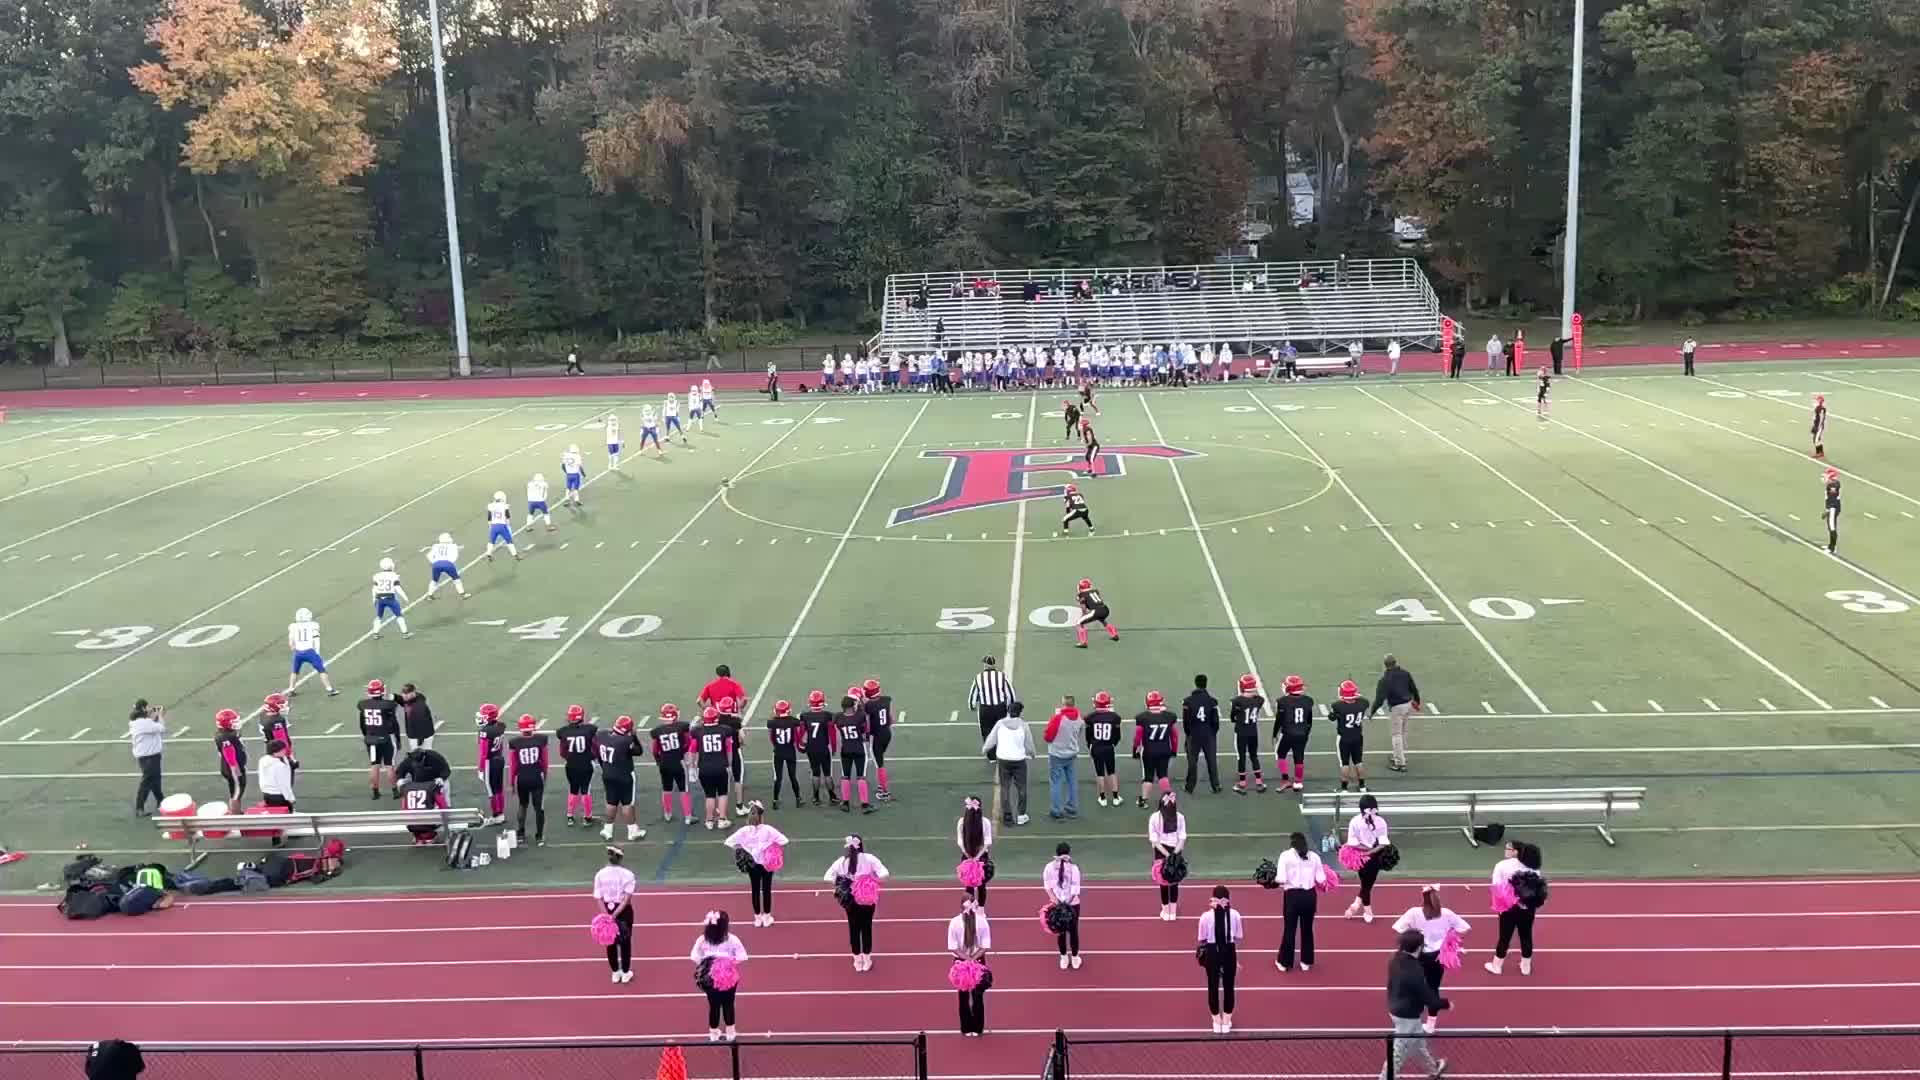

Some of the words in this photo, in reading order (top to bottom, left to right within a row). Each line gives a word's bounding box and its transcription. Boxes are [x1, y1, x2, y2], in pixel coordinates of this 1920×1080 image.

[1375, 597, 1536, 622] 40
[508, 614, 662, 640] 40
[364, 709, 382, 726] 55
[878, 708, 887, 725] 9
[1196, 706, 1206, 722] 4
[1244, 707, 1257, 724] 14
[1294, 707, 1304, 723] 8
[1345, 711, 1362, 728] 24
[810, 722, 820, 738] 7
[841, 725, 858, 739] 15
[1093, 723, 1112, 740] 68
[1149, 724, 1168, 740] 77
[566, 736, 586, 753] 70
[659, 732, 680, 752] 56
[702, 734, 722, 752] 65
[519, 747, 539, 764] 88
[600, 744, 615, 764] 67
[407, 790, 426, 808] 62
